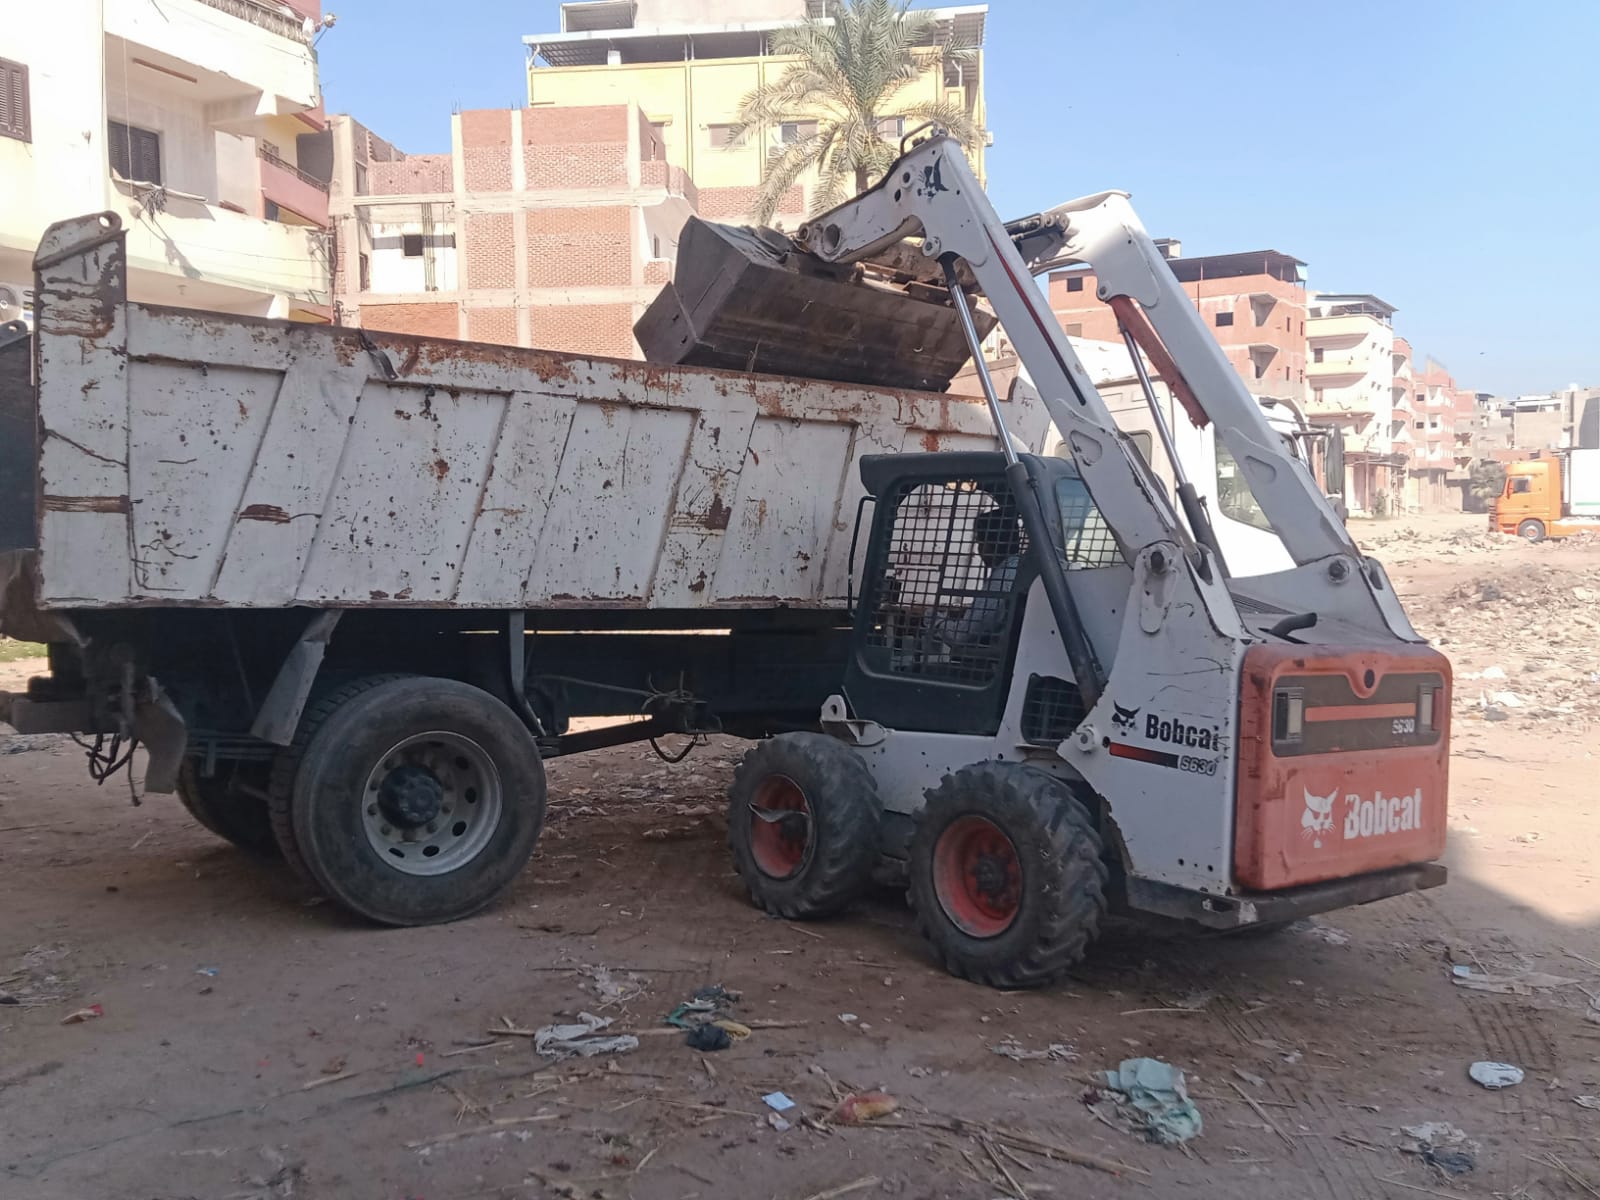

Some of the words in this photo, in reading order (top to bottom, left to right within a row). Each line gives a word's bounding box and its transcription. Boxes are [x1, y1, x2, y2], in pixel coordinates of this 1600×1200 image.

[1145, 713, 1219, 751] Bobcat
[1180, 755, 1217, 776] S630
[1343, 788, 1422, 840] Bobcat
